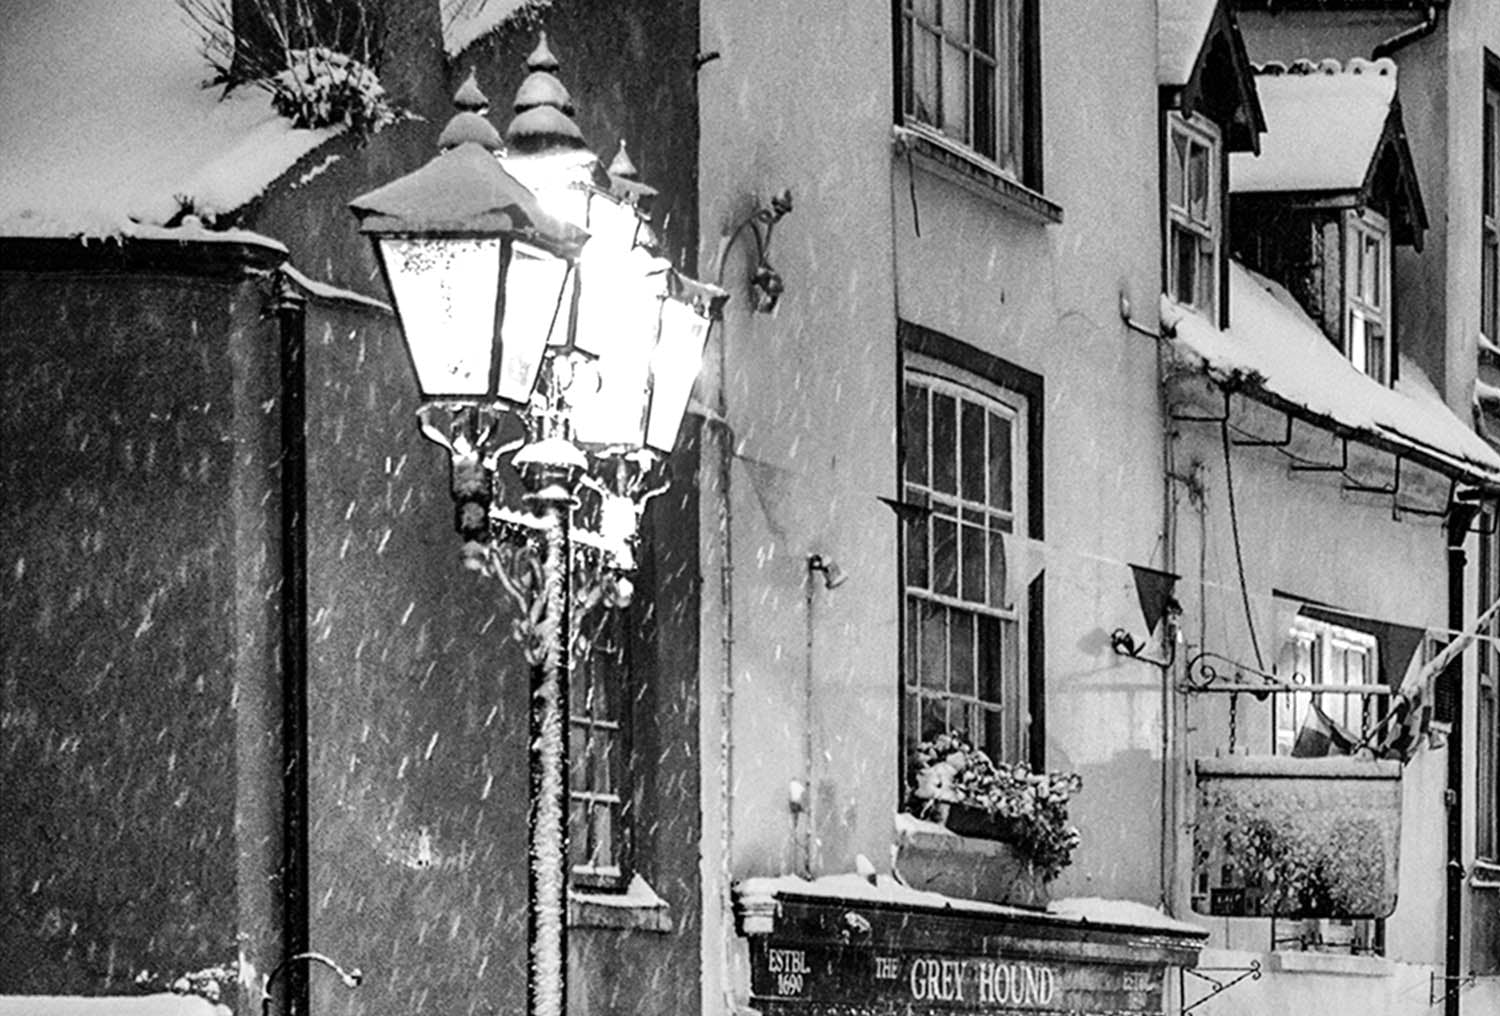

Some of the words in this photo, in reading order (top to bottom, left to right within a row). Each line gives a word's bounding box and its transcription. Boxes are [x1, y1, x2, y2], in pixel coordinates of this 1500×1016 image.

[876, 957, 898, 981] THE
[910, 957, 967, 1001] GREY
[979, 960, 1054, 1005] HOUND
